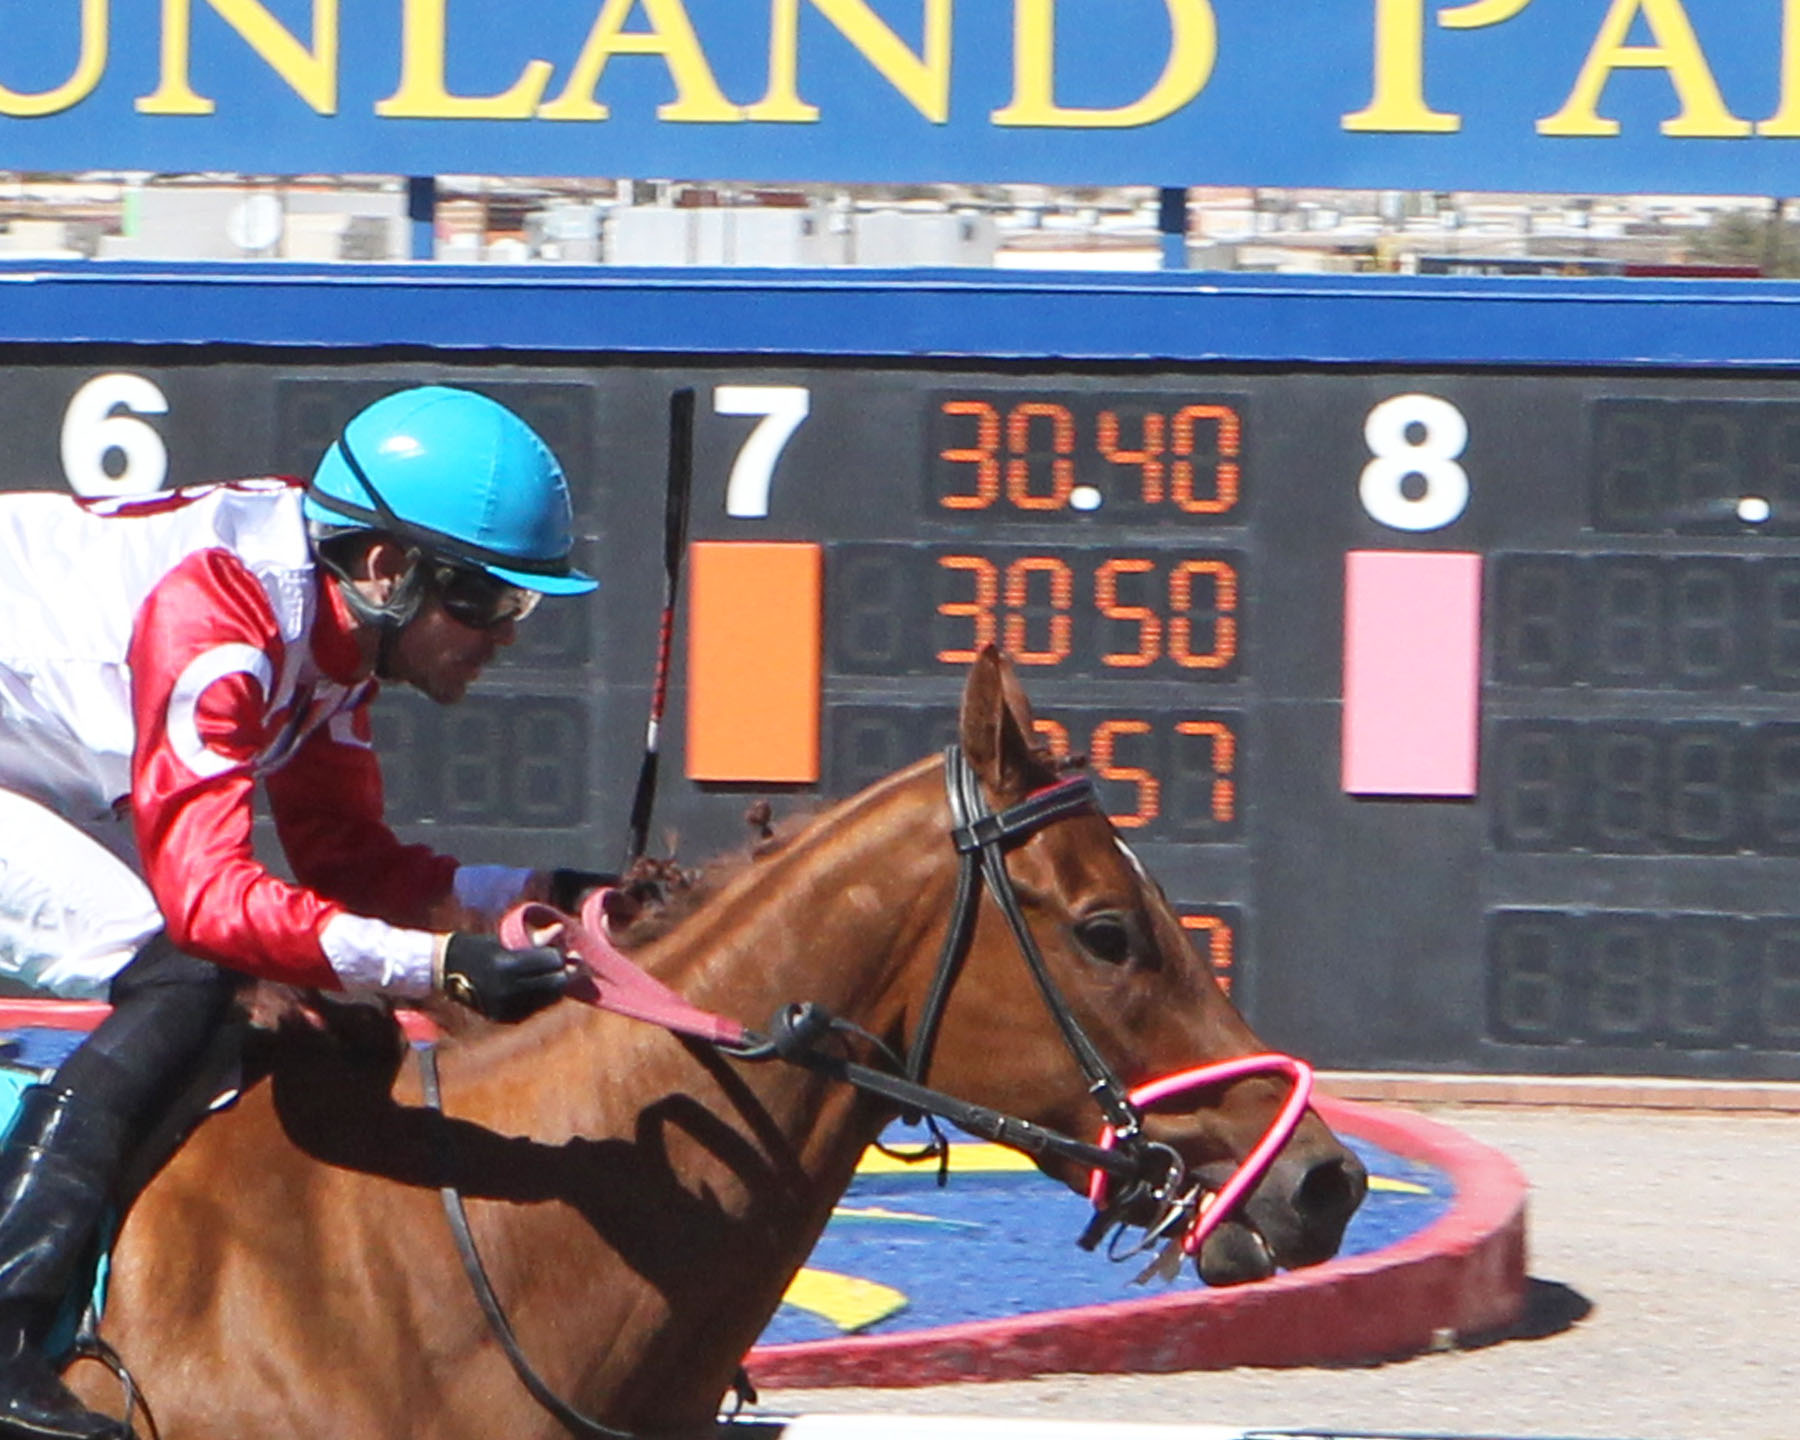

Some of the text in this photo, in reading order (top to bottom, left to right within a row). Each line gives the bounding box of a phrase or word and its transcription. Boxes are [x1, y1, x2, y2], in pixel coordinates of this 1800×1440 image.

[1342, 0, 1800, 137] PA
[61, 373, 168, 492] 6
[713, 385, 810, 518] 7
[1358, 393, 1470, 531] 8
[937, 554, 1238, 670] 3050
